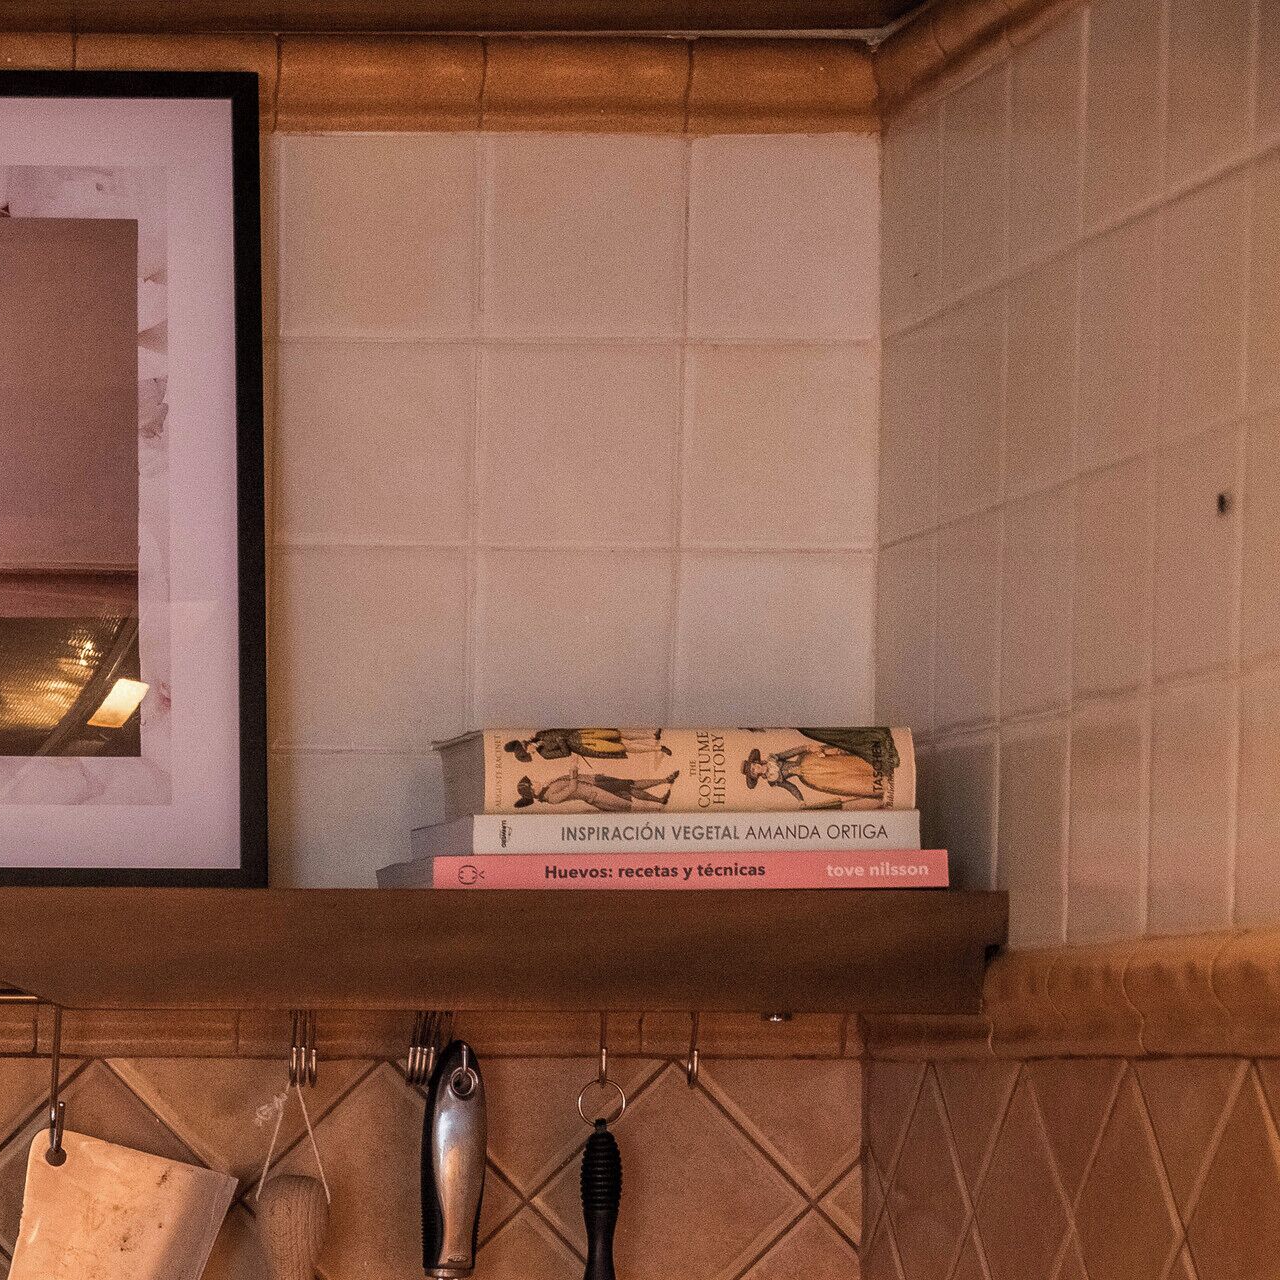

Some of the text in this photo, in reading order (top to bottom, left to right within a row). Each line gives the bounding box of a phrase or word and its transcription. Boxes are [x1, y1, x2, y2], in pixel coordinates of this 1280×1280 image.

[689, 759, 697, 777] THE
[697, 731, 710, 808] COSTUME
[711, 733, 726, 805] HISTORY
[872, 741, 884, 793] TASCHEN
[560, 821, 889, 842] INSPIRACIÓN VEGETAL AMANDA ORTIGA
[544, 862, 767, 882] Huevos: recetas y técnicas
[826, 862, 929, 878] tove nilsson
